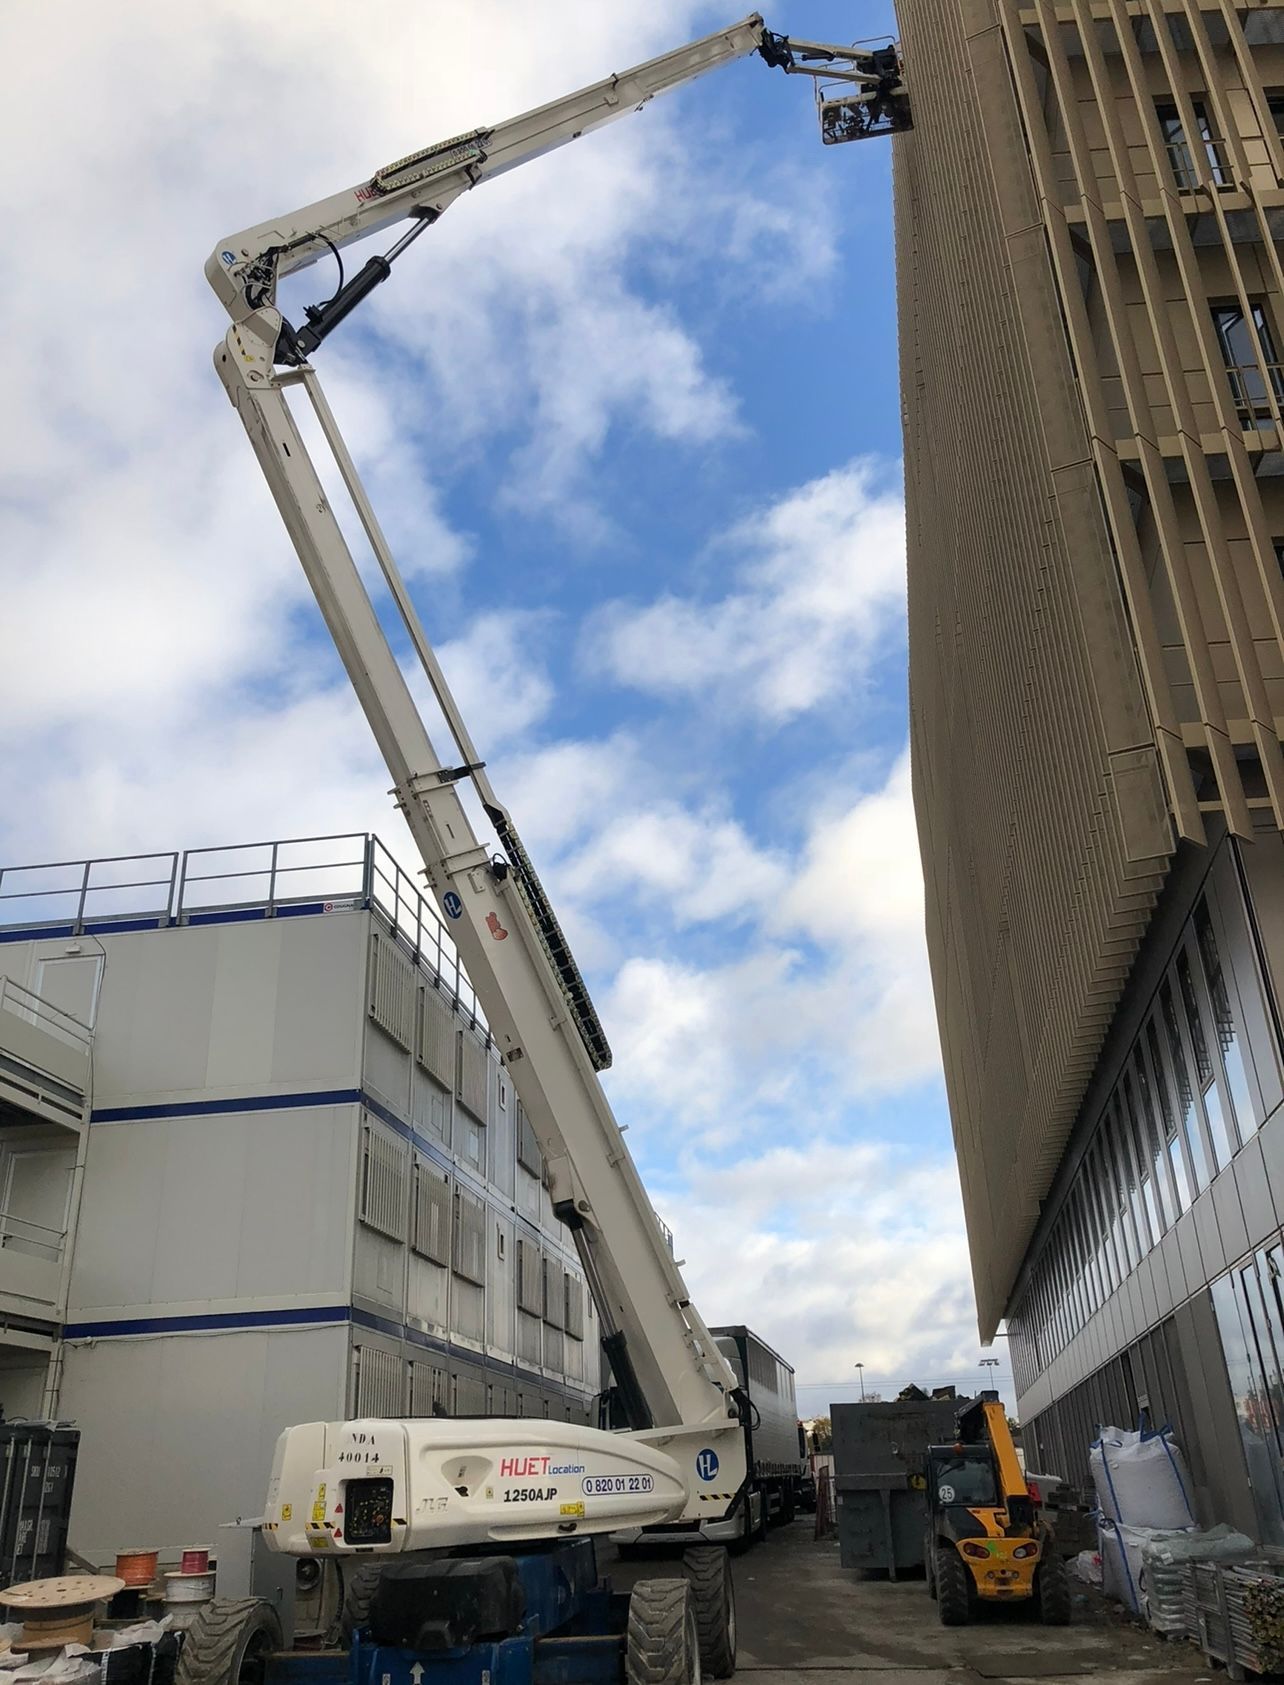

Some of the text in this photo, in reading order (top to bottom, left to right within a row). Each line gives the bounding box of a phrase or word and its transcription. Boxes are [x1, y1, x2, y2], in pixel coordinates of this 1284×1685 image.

[338, 1452, 379, 1463] 40014
[501, 1457, 585, 1477] HUET Location
[698, 1453, 718, 1479] HL
[586, 1476, 651, 1493] 0 820 01 22 01
[504, 1488, 558, 1503] 1250AJP
[941, 1487, 953, 1500] 25
